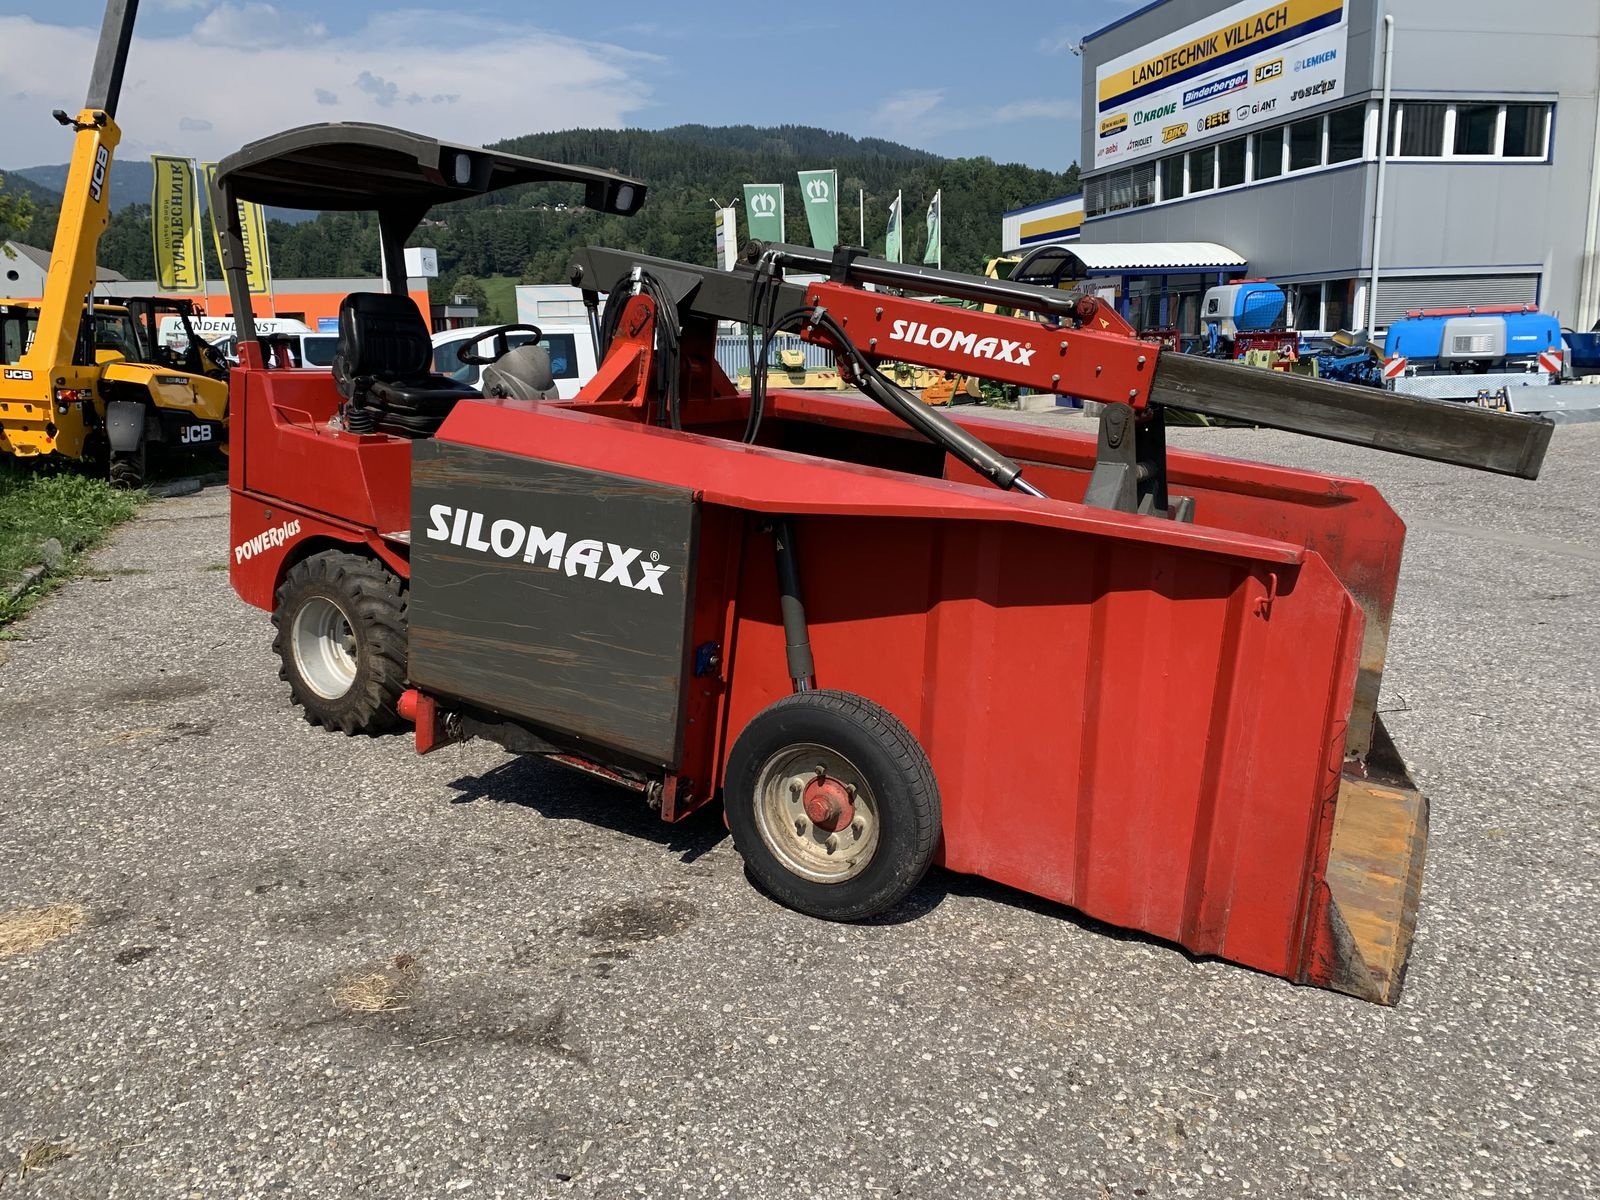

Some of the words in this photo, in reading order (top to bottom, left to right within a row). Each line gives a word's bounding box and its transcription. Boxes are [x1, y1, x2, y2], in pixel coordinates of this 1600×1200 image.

[1132, 35, 1218, 85] LANDTECHNIK
[1224, 7, 1288, 47] VILLACH
[1302, 49, 1337, 69] LEMKEN
[1256, 61, 1282, 82] JCB
[1184, 73, 1247, 103] Binderberger
[1143, 102, 1177, 124] KRONE
[92, 145, 108, 201] JCB
[5, 370, 33, 380] JCB
[181, 424, 212, 443] JCB
[234, 519, 301, 565] POWERplus
